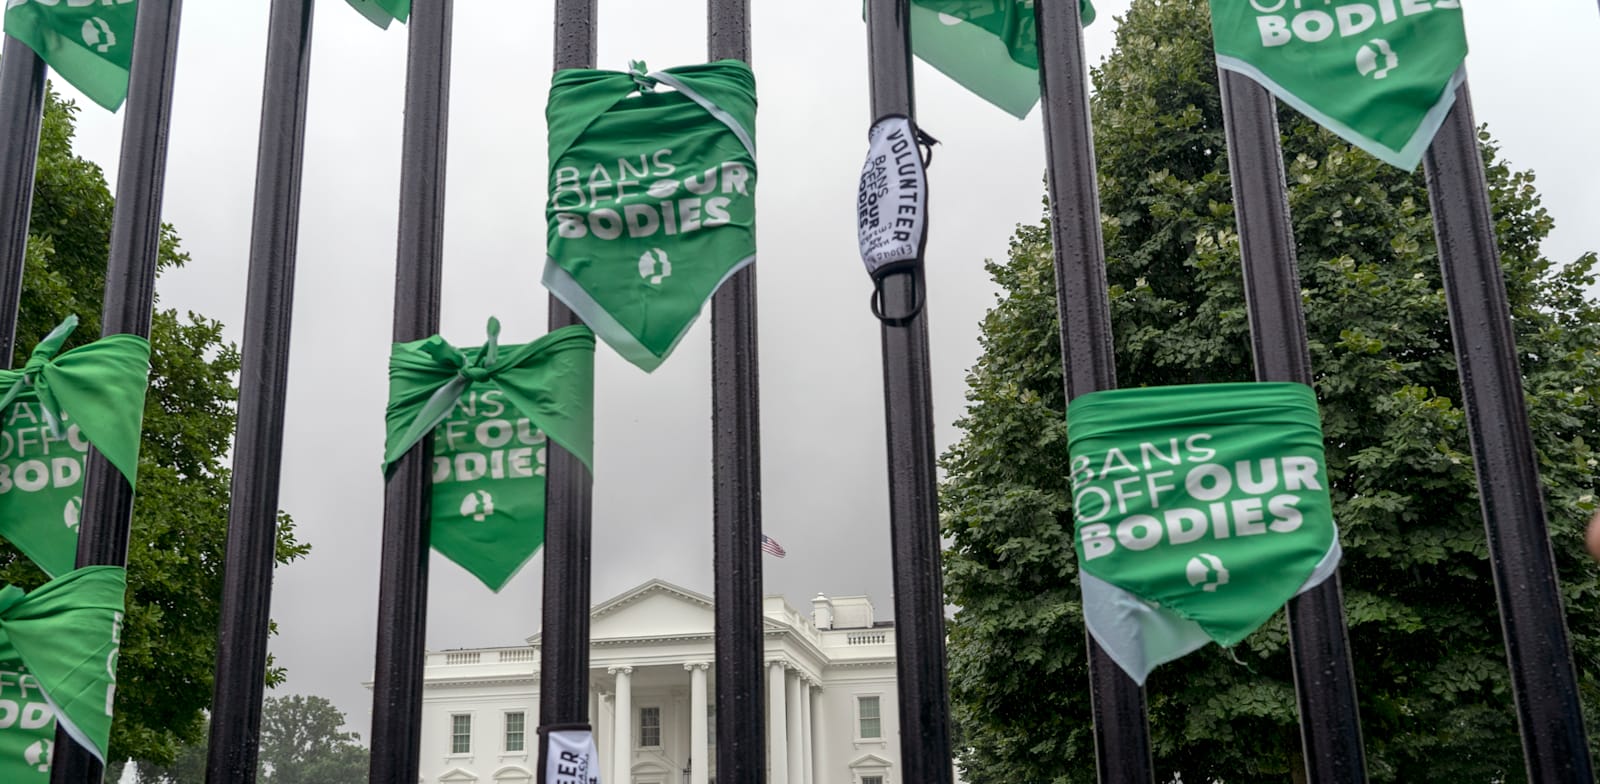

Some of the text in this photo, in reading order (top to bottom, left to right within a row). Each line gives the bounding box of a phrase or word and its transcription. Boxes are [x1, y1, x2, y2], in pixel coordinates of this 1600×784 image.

[1256, 0, 1460, 47] BODIE
[552, 161, 749, 210] OFF OUR
[556, 149, 676, 191] BANS
[874, 154, 889, 198] BANS
[886, 128, 918, 242] VOLUNTEER
[556, 197, 731, 240] BODIES
[868, 192, 880, 230] OUR
[446, 390, 504, 418] NS
[1070, 433, 1216, 490] BANS
[1074, 456, 1323, 521] OFF OUR
[1080, 494, 1303, 561] BODIES
